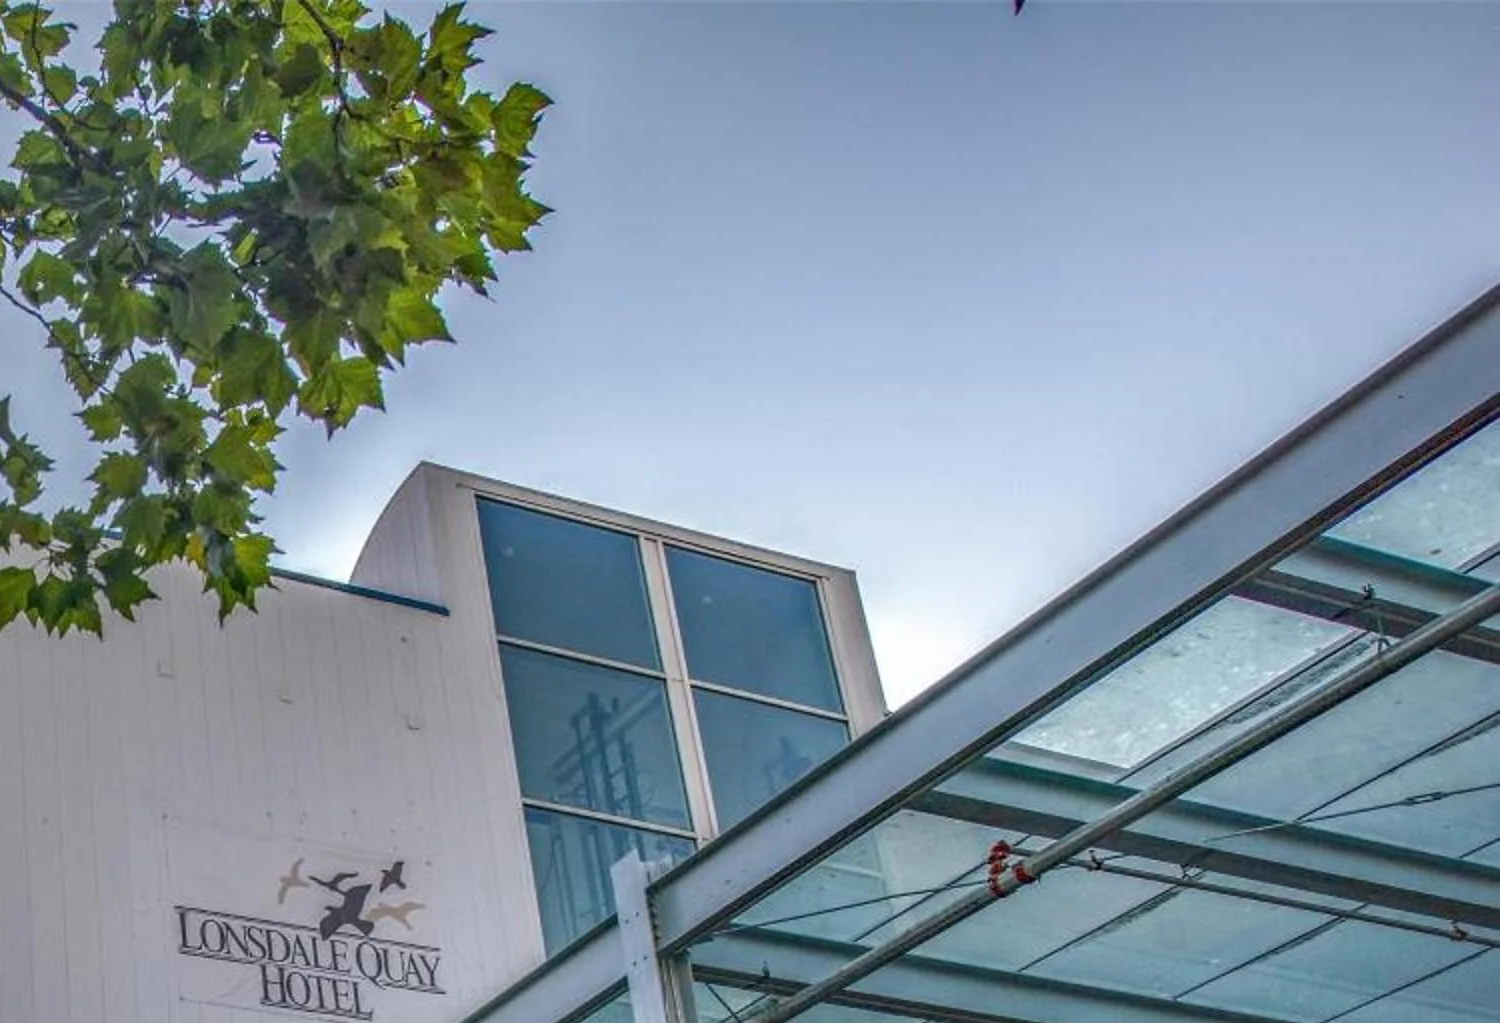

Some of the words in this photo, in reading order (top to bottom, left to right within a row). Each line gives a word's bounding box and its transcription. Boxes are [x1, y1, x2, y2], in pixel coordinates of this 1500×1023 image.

[178, 910, 352, 974] LONSDALE
[355, 941, 442, 990] QUAY
[261, 964, 375, 1017] HOTEL
